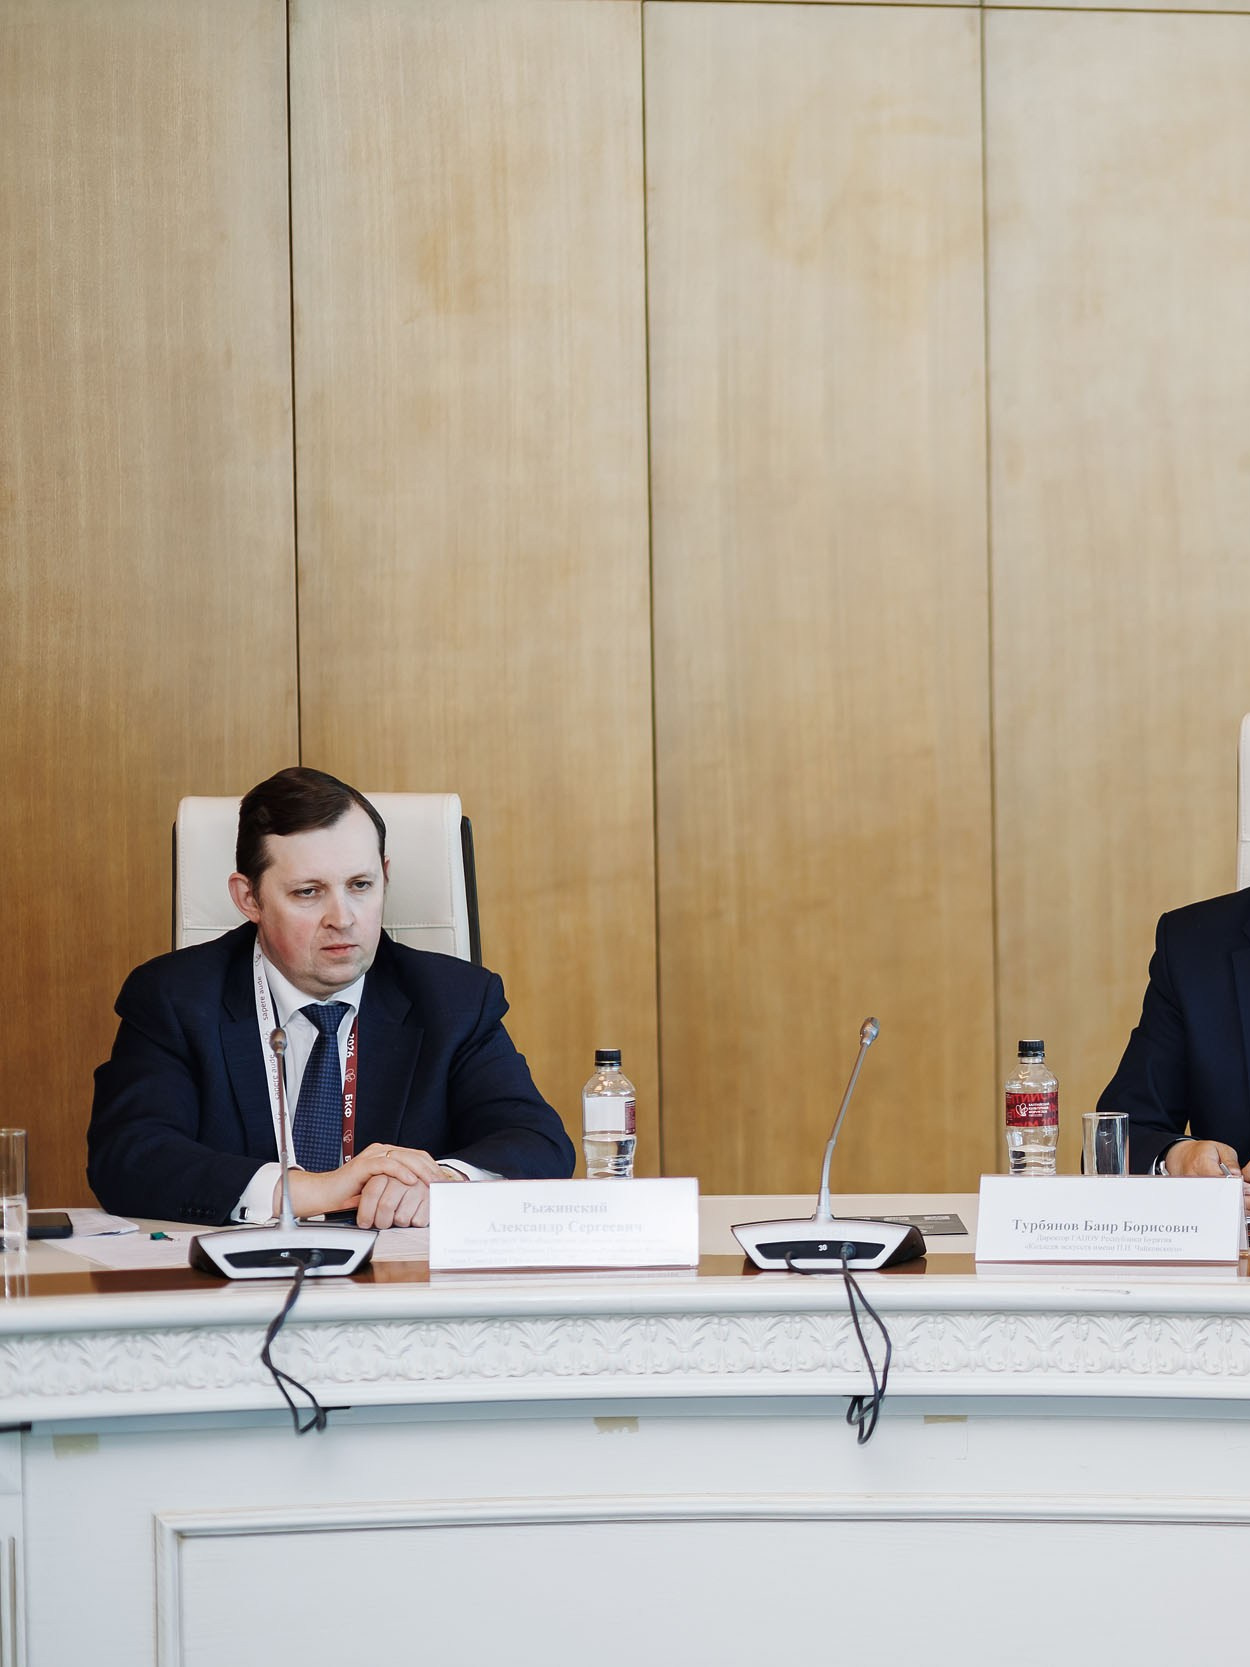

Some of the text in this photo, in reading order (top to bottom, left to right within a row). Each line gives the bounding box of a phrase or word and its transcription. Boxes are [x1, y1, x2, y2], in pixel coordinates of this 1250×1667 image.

[257, 975, 269, 1021] sapere aude
[344, 1094, 354, 1118] БКФ
[522, 1200, 608, 1215] Рыжинский
[487, 1221, 643, 1236] Александр Сергеевич
[1011, 1219, 1199, 1234] Турбянов Баир Борисович
